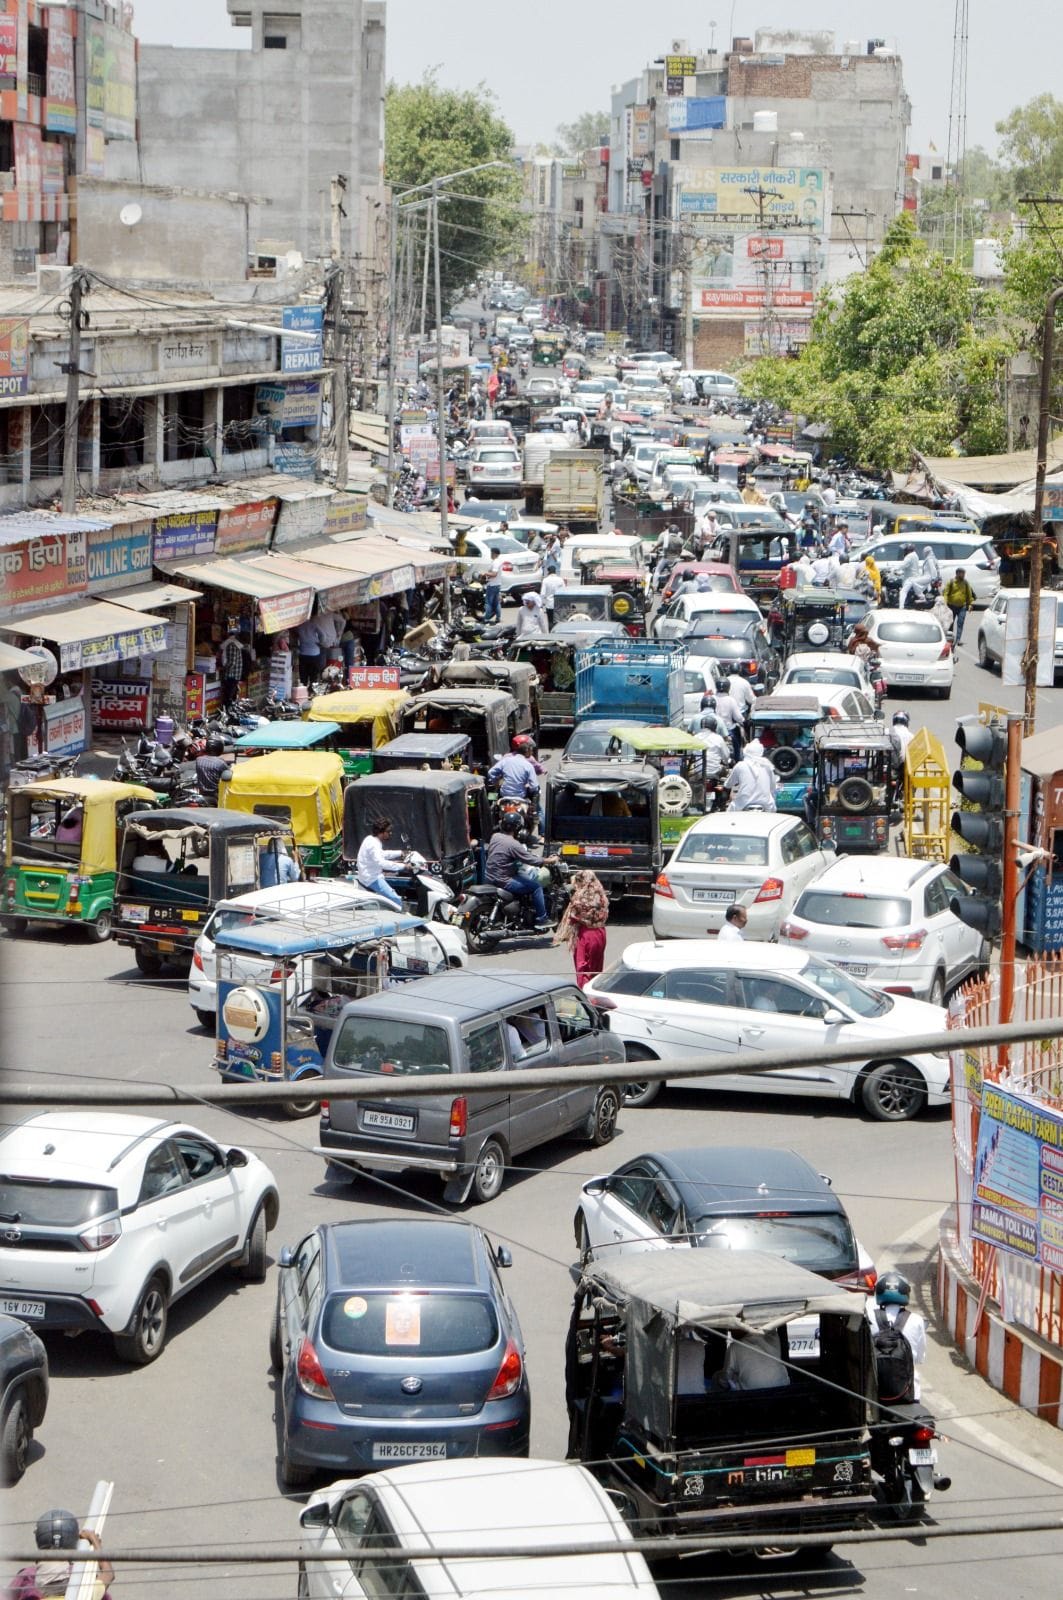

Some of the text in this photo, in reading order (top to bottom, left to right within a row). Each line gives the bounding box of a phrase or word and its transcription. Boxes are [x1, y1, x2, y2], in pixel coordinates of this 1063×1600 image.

[720, 169, 797, 184] सरकारी नौकरी
[285, 353, 320, 368] REPAIR
[255, 389, 285, 402] LAPTOP
[27, 533, 63, 572] डिपो
[88, 545, 128, 578] ONLINE
[368, 672, 380, 688] बुक
[369, 1114, 412, 1127] HR 95A 0921
[1006, 1101, 1032, 1134] RATAN
[1035, 1114, 1057, 1145] FARM
[980, 1206, 1004, 1228] BAMLA
[1004, 1214, 1021, 1236] TOLL
[1021, 1222, 1036, 1242] TAX
[21, 1302, 45, 1315] 0773
[791, 1340, 814, 1351] 2774
[379, 1445, 446, 1457] HR26CF2964
